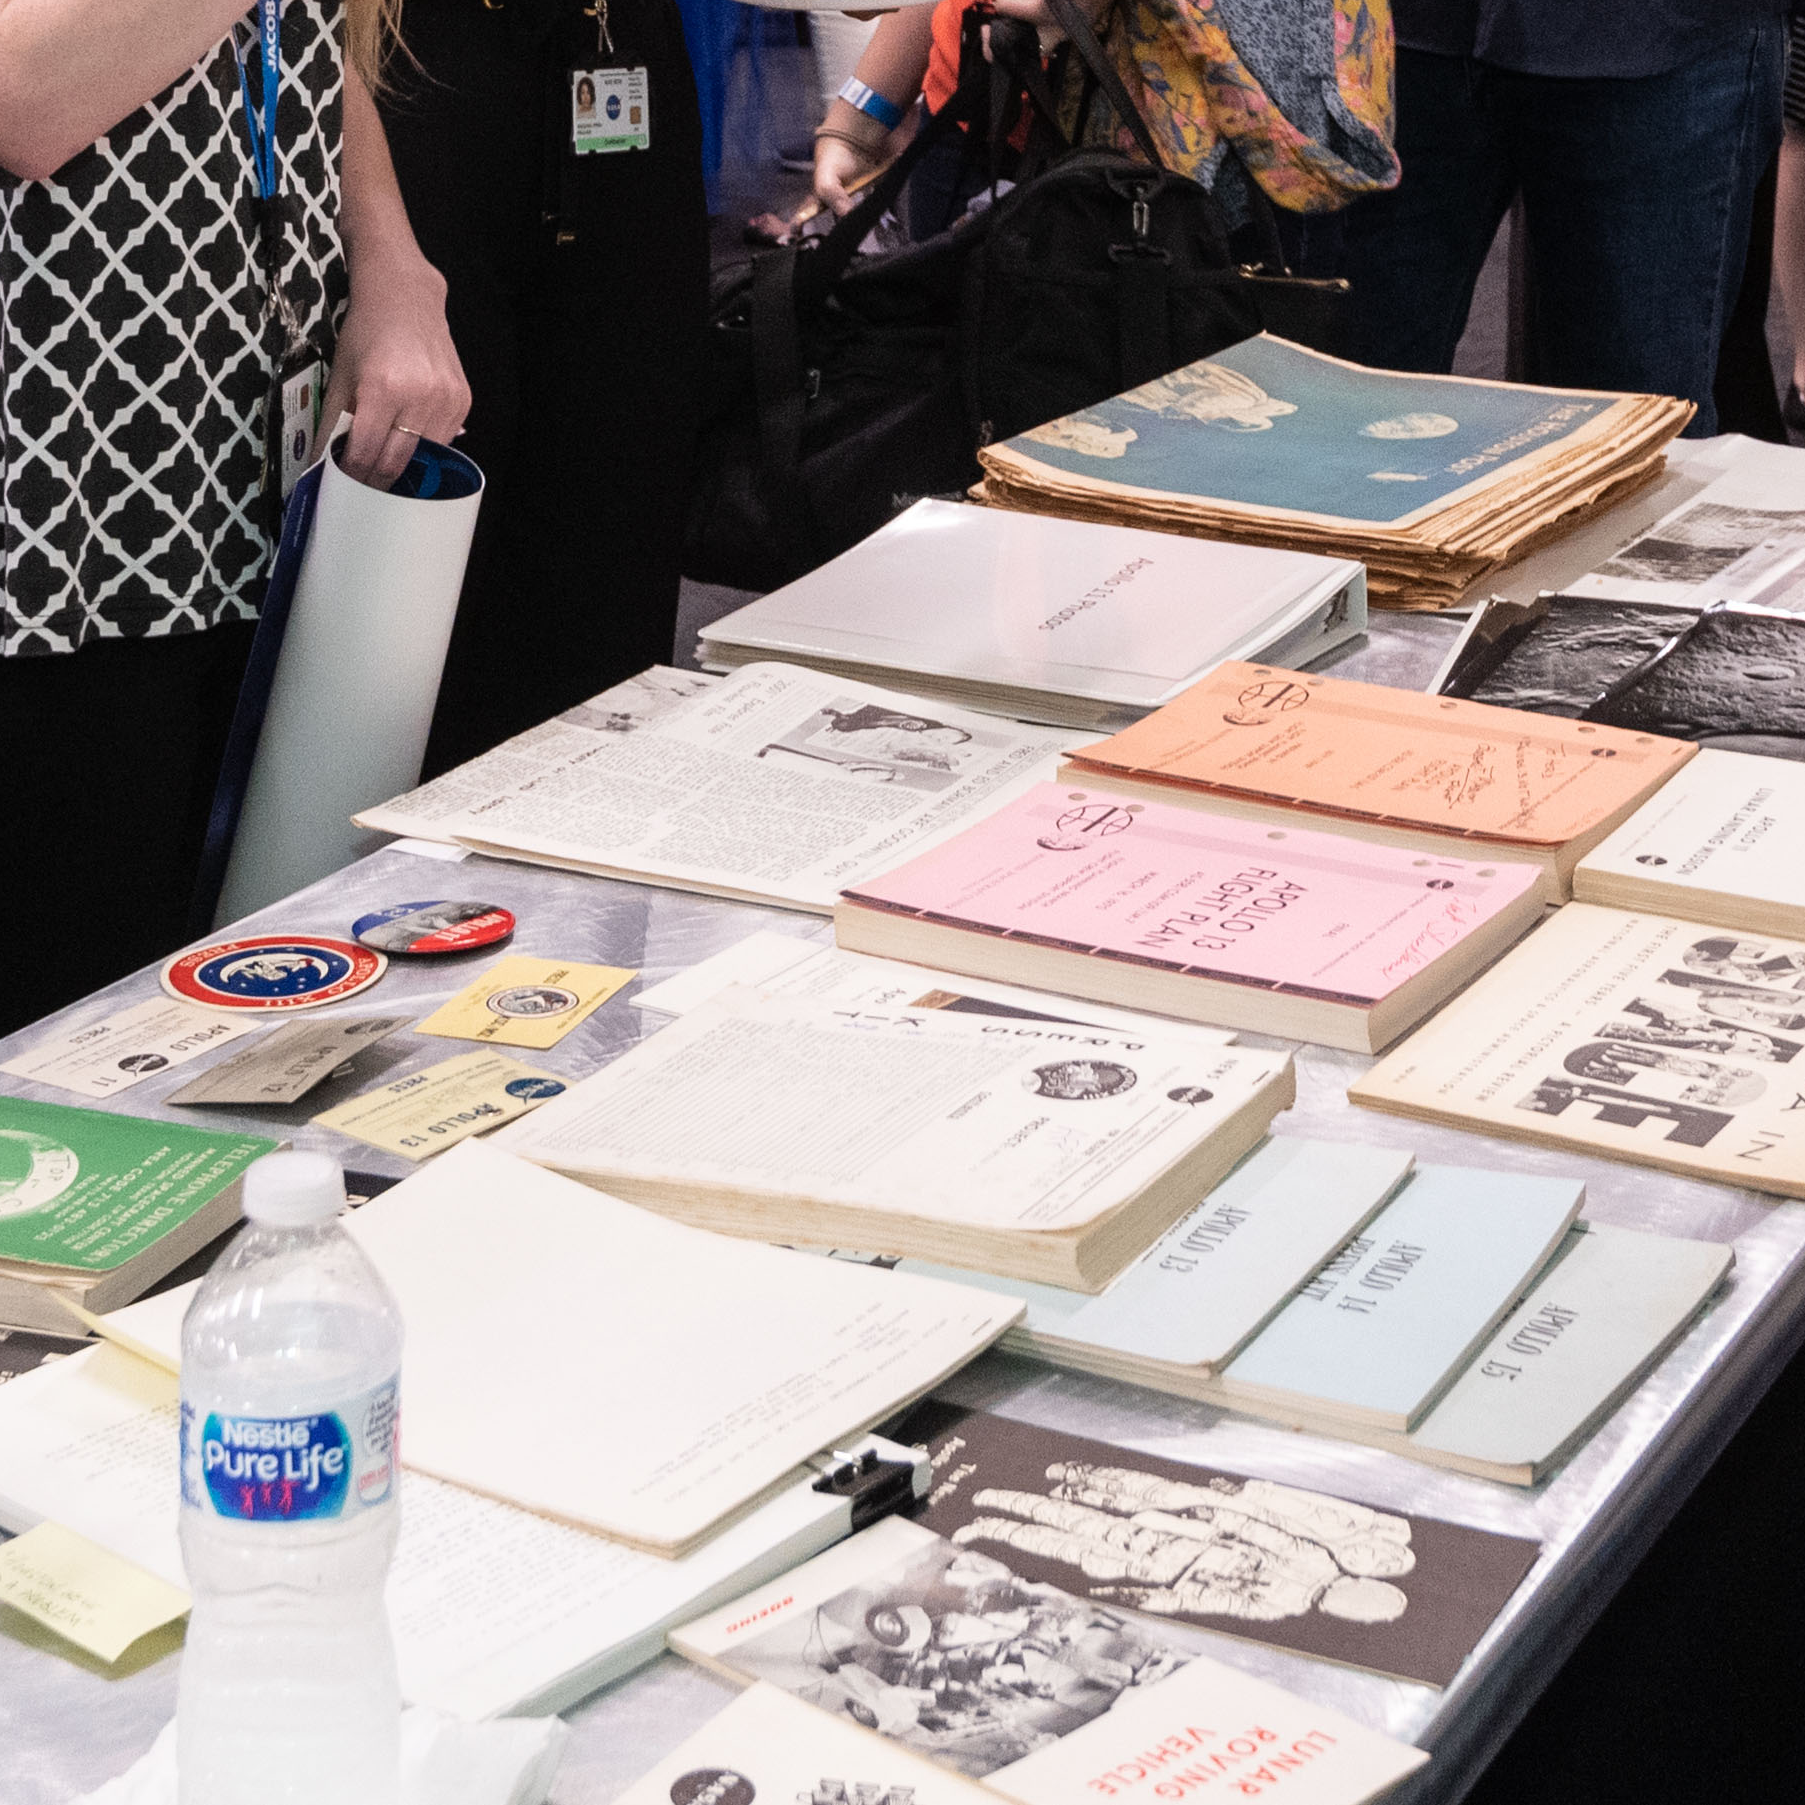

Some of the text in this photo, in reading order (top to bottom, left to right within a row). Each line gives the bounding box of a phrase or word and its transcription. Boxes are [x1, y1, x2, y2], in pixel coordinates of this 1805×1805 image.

[1439, 453, 1499, 475] POST
[1036, 557, 1155, 631] Apollo 11 Photos
[1738, 786, 1776, 812] LUNAR
[906, 812, 938, 827] ARE
[1705, 812, 1750, 845] LANDING
[1736, 815, 1779, 845] APOLLO
[852, 826, 917, 860] GOODWILL
[820, 859, 861, 879] GUYS
[1673, 845, 1717, 876] MISSION
[448, 912, 507, 934] APOLLO
[1130, 866, 1280, 949] FLIGHT PLAN
[1185, 879, 1315, 952] APOLLO 13
[1593, 918, 1642, 953] NATIONAL
[1652, 924, 1680, 940] THE
[178, 943, 238, 967] PRESS
[1628, 940, 1663, 962] FIRST
[264, 958, 373, 1006] APOLLO XIII
[1539, 955, 1602, 1002] AERONAUTICS
[1608, 963, 1639, 981] FIVE
[1579, 982, 1617, 1006] YEARS
[833, 1010, 927, 1029] KIT
[1505, 1008, 1541, 1032] SPACE
[88, 1023, 234, 1087] APOLLO 11
[981, 1025, 1146, 1052] PRESS
[1506, 1028, 1564, 1070] PICTORIAL
[1433, 1031, 1514, 1095] ADMINISTRATION
[385, 1075, 430, 1093] PRESS
[1470, 1070, 1517, 1103] REVIEW
[396, 1101, 499, 1148] APOLLO 13
[135, 1145, 176, 1167] AREA
[1734, 1129, 1786, 1162] IN
[102, 1167, 149, 1191] CODE
[160, 1142, 262, 1205] TELEPHONE
[165, 1147, 221, 1180] MANNED
[82, 1192, 115, 1208] 713
[104, 1181, 177, 1226] SPACECRAFT
[68, 1226, 114, 1251] CENTER
[78, 1205, 177, 1264] DIRECTORY
[1174, 1203, 1254, 1254] APOLLO
[1154, 1252, 1201, 1273] 13
[1320, 1236, 1377, 1276] PRESS
[1334, 1240, 1428, 1315] APOLLO 14
[1477, 1302, 1581, 1382] APOLLO 15
[205, 1440, 279, 1481] Pure
[284, 1444, 345, 1492] Life
[723, 1592, 797, 1635] BOEING
[1080, 1721, 1221, 1798] VEHICLE
[1143, 1724, 1285, 1803] ROVING
[1221, 1728, 1342, 1798] LUNAR
